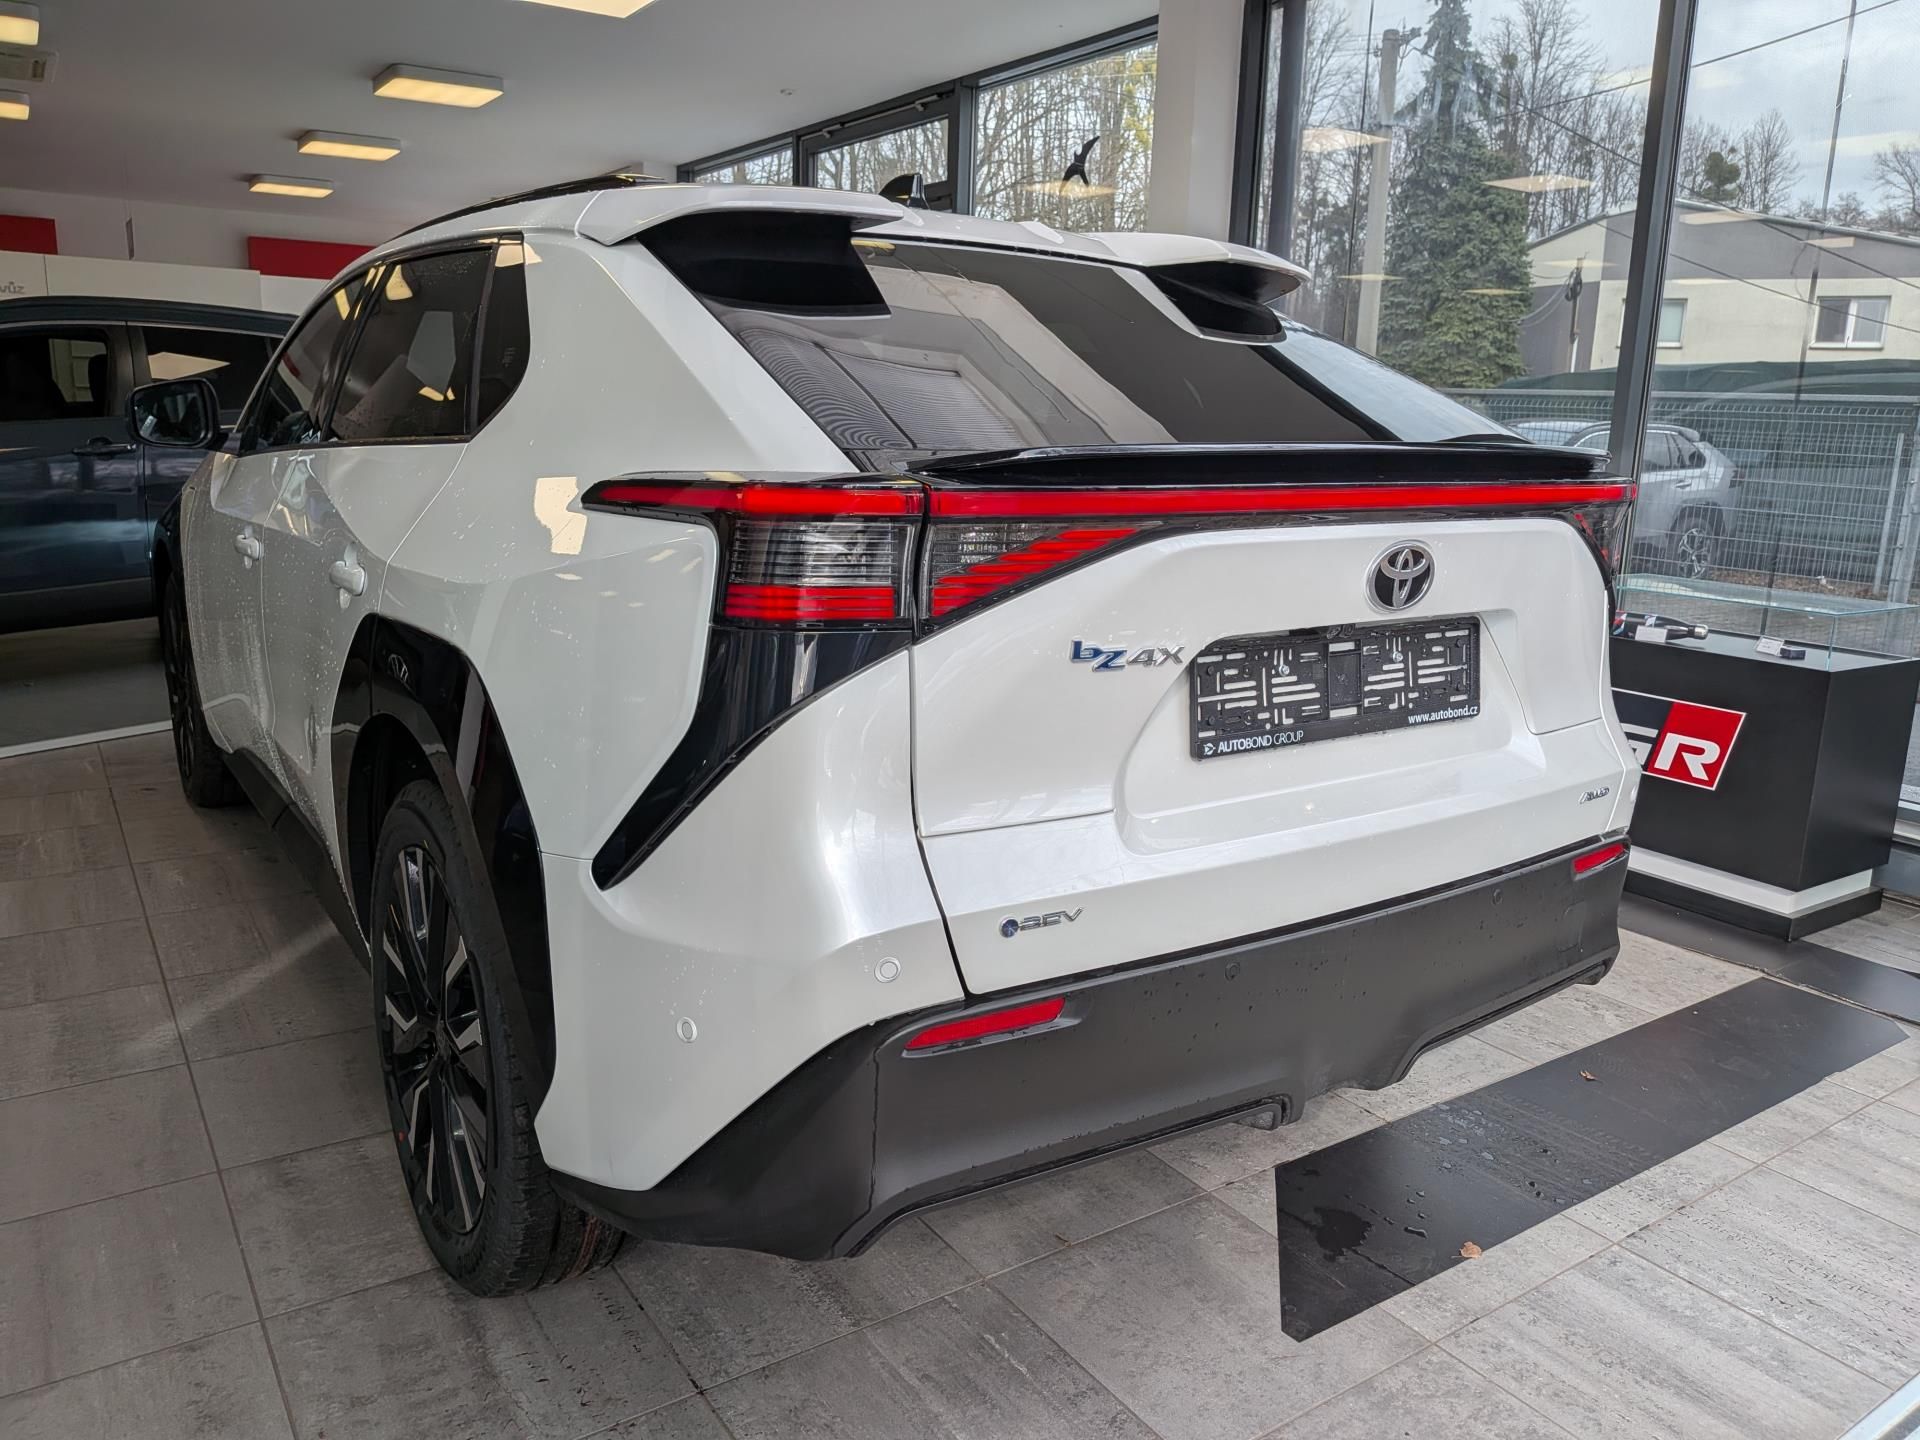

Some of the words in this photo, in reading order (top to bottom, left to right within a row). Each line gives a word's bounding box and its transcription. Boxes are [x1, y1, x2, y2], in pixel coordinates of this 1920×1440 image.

[1407, 704, 1479, 724] www.autobond.cz
[1217, 734, 1273, 754] AUTOBOND
[1273, 730, 1304, 746] GROUP
